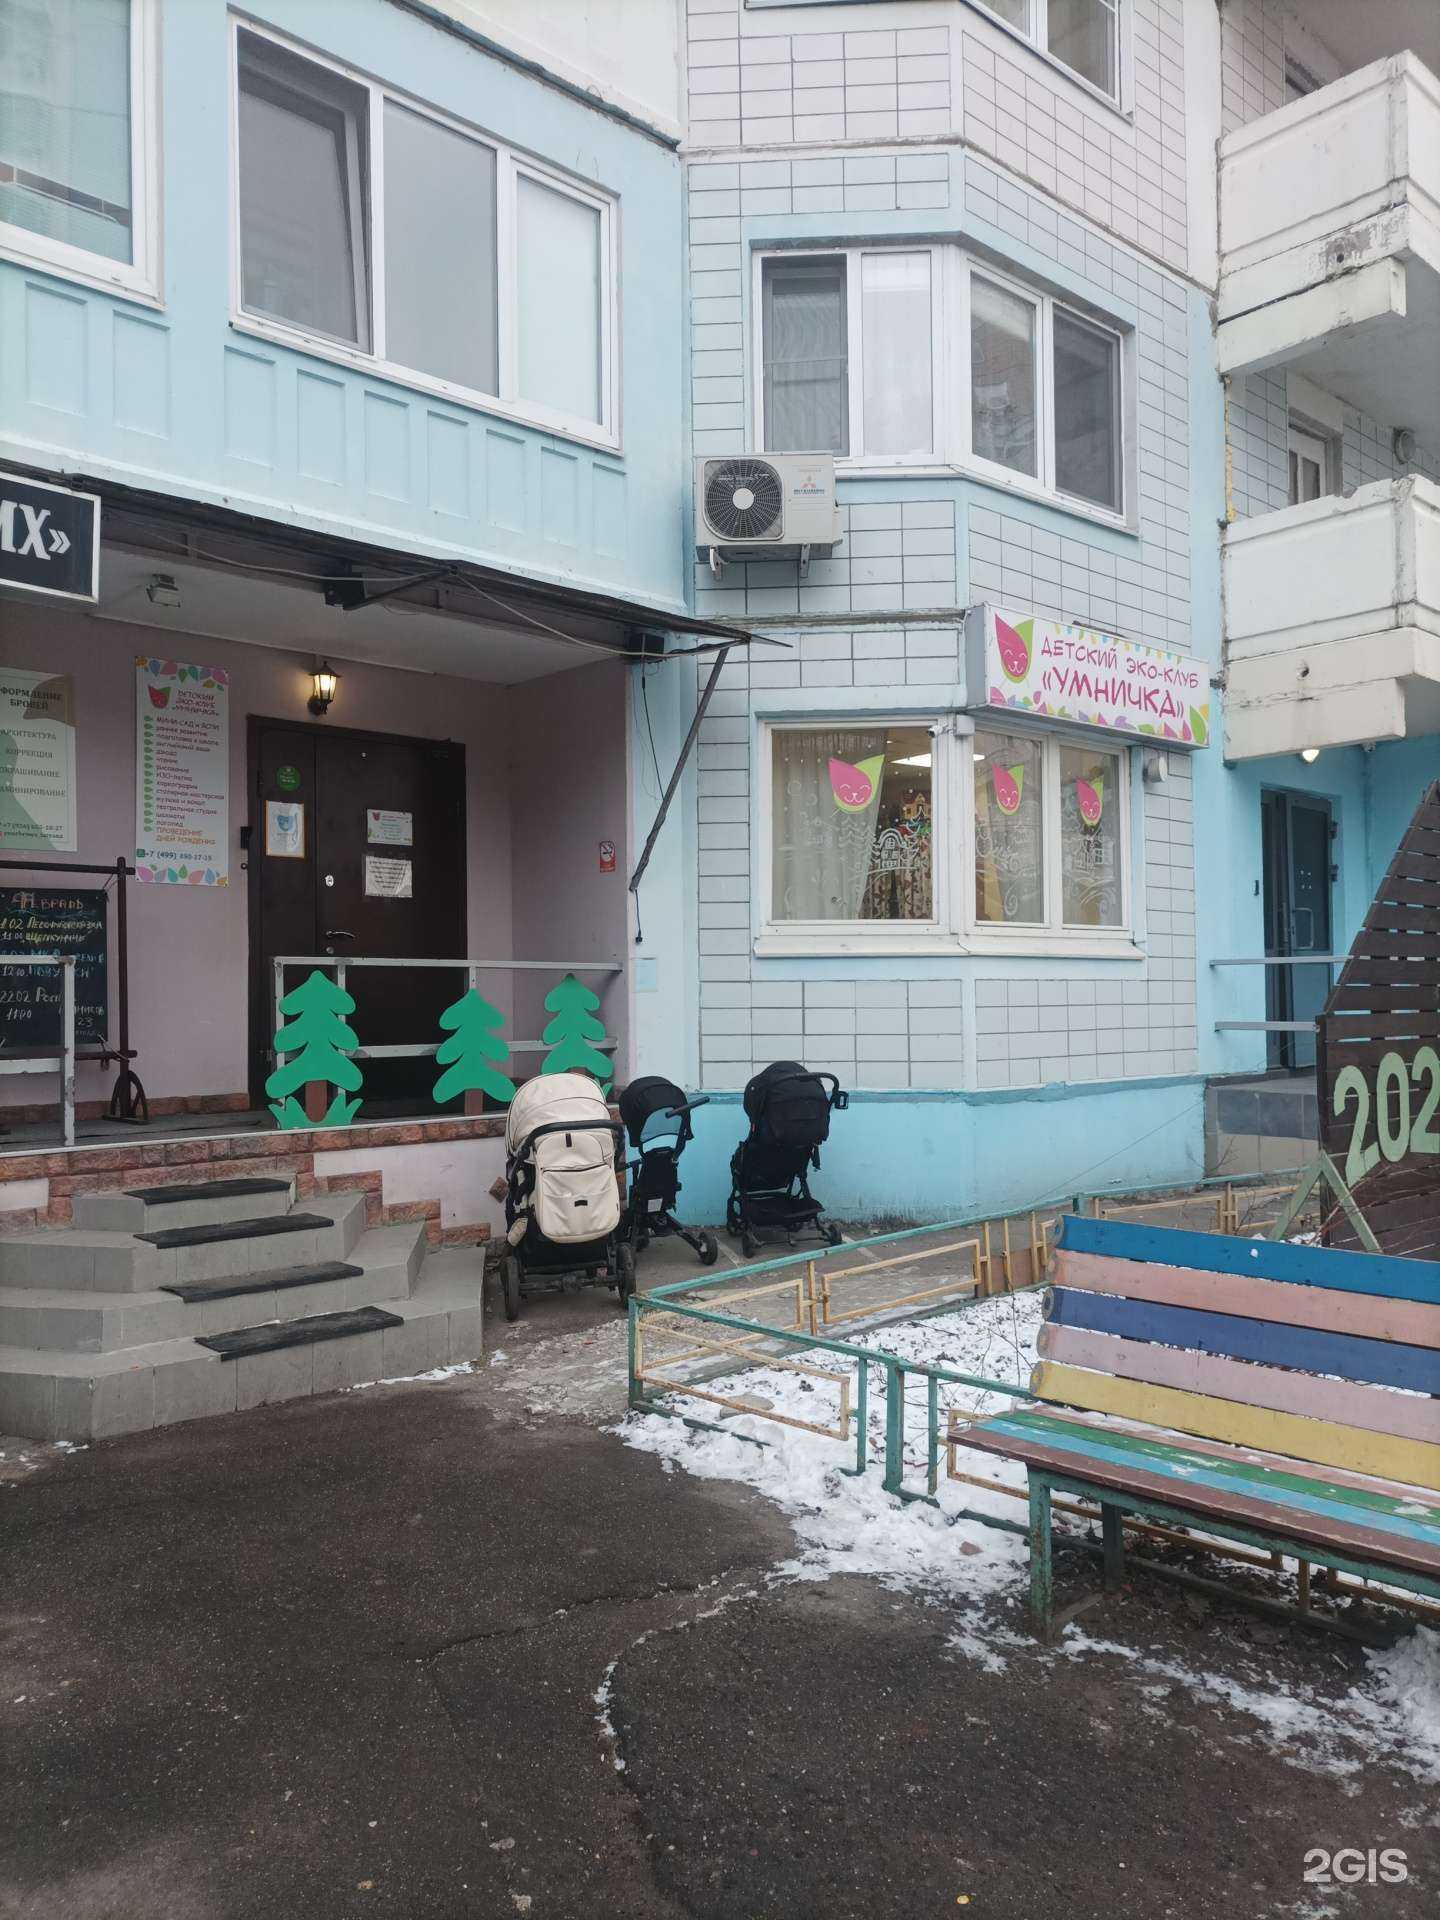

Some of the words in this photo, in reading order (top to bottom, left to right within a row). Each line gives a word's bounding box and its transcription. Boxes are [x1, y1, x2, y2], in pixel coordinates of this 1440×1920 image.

[1041, 636, 1118, 670] ДЕТСКИЙ
[1126, 657, 1199, 689] ЭКО-КЛУБ
[1042, 666, 1185, 719] «УМНИЧКА»
[1333, 1045, 1440, 1190] 202
